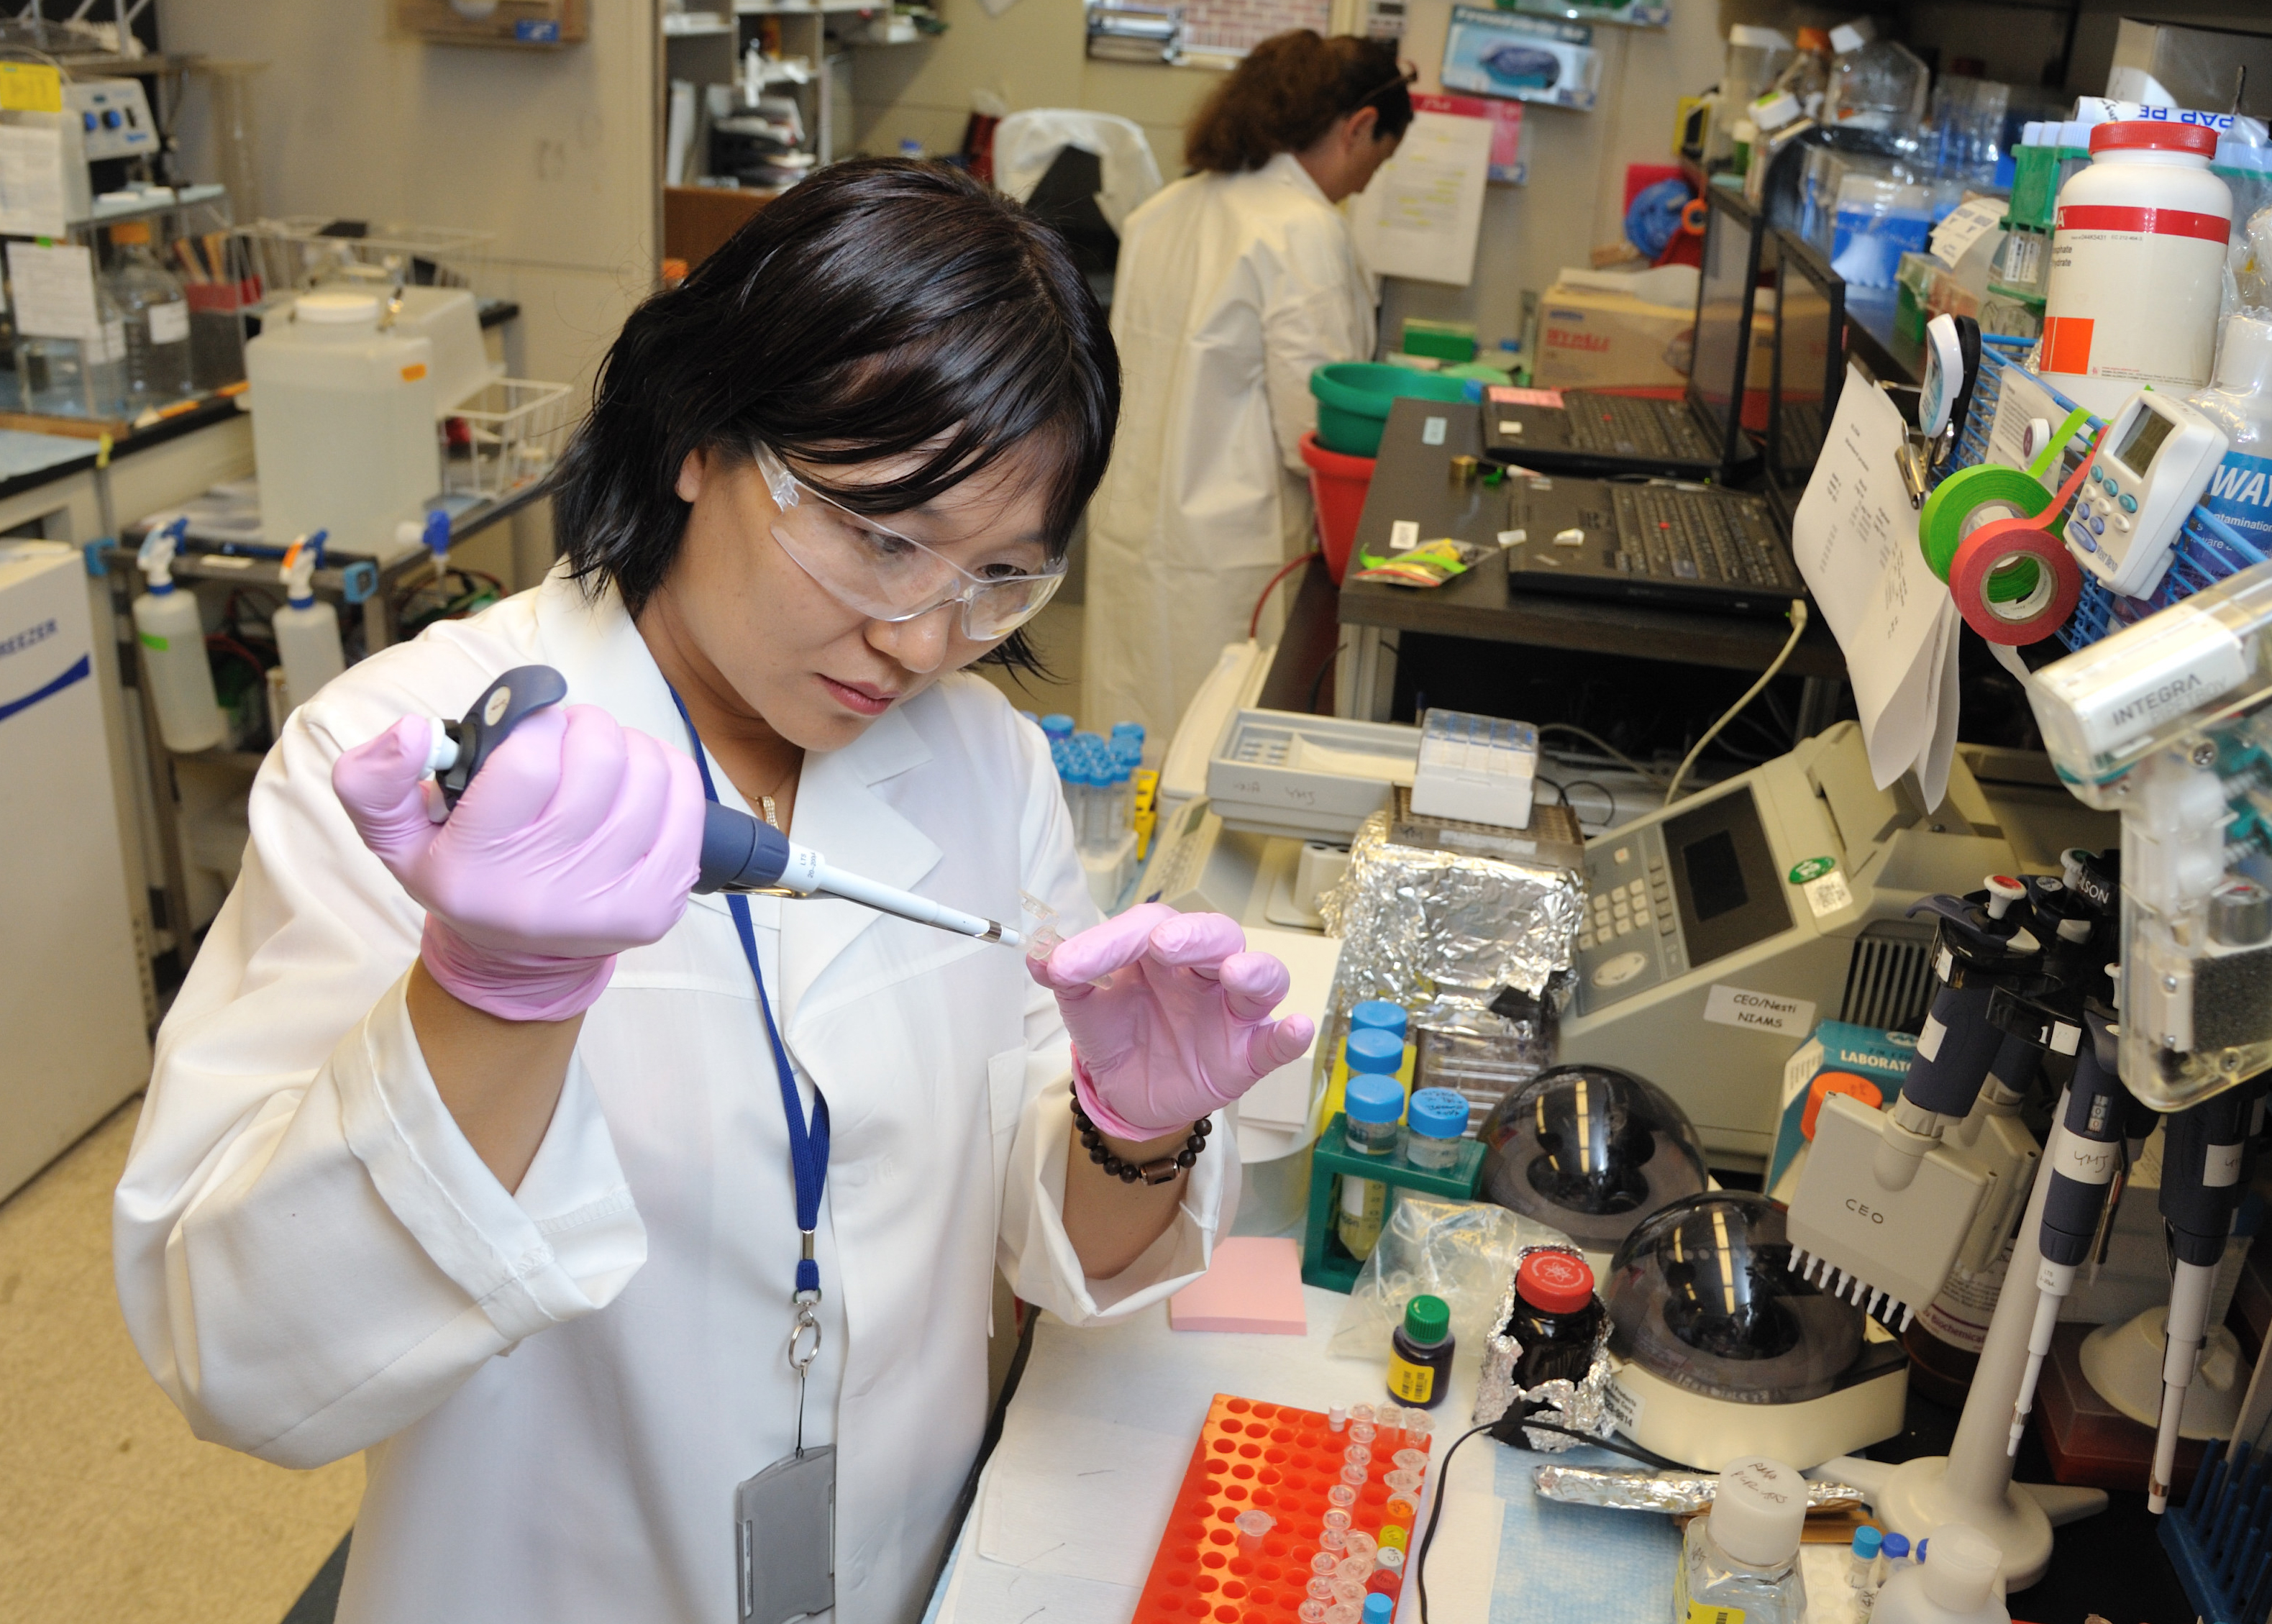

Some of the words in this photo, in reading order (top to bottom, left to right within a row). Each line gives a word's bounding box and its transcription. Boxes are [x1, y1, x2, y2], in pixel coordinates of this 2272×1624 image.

[2181, 111, 2235, 129] PAP
[2112, 672, 2202, 726] INTEGRA
[1733, 994, 1797, 1013] CEO/Nesti
[1737, 1011, 1783, 1028] NIAMS
[1845, 1198, 1884, 1225] CEO
